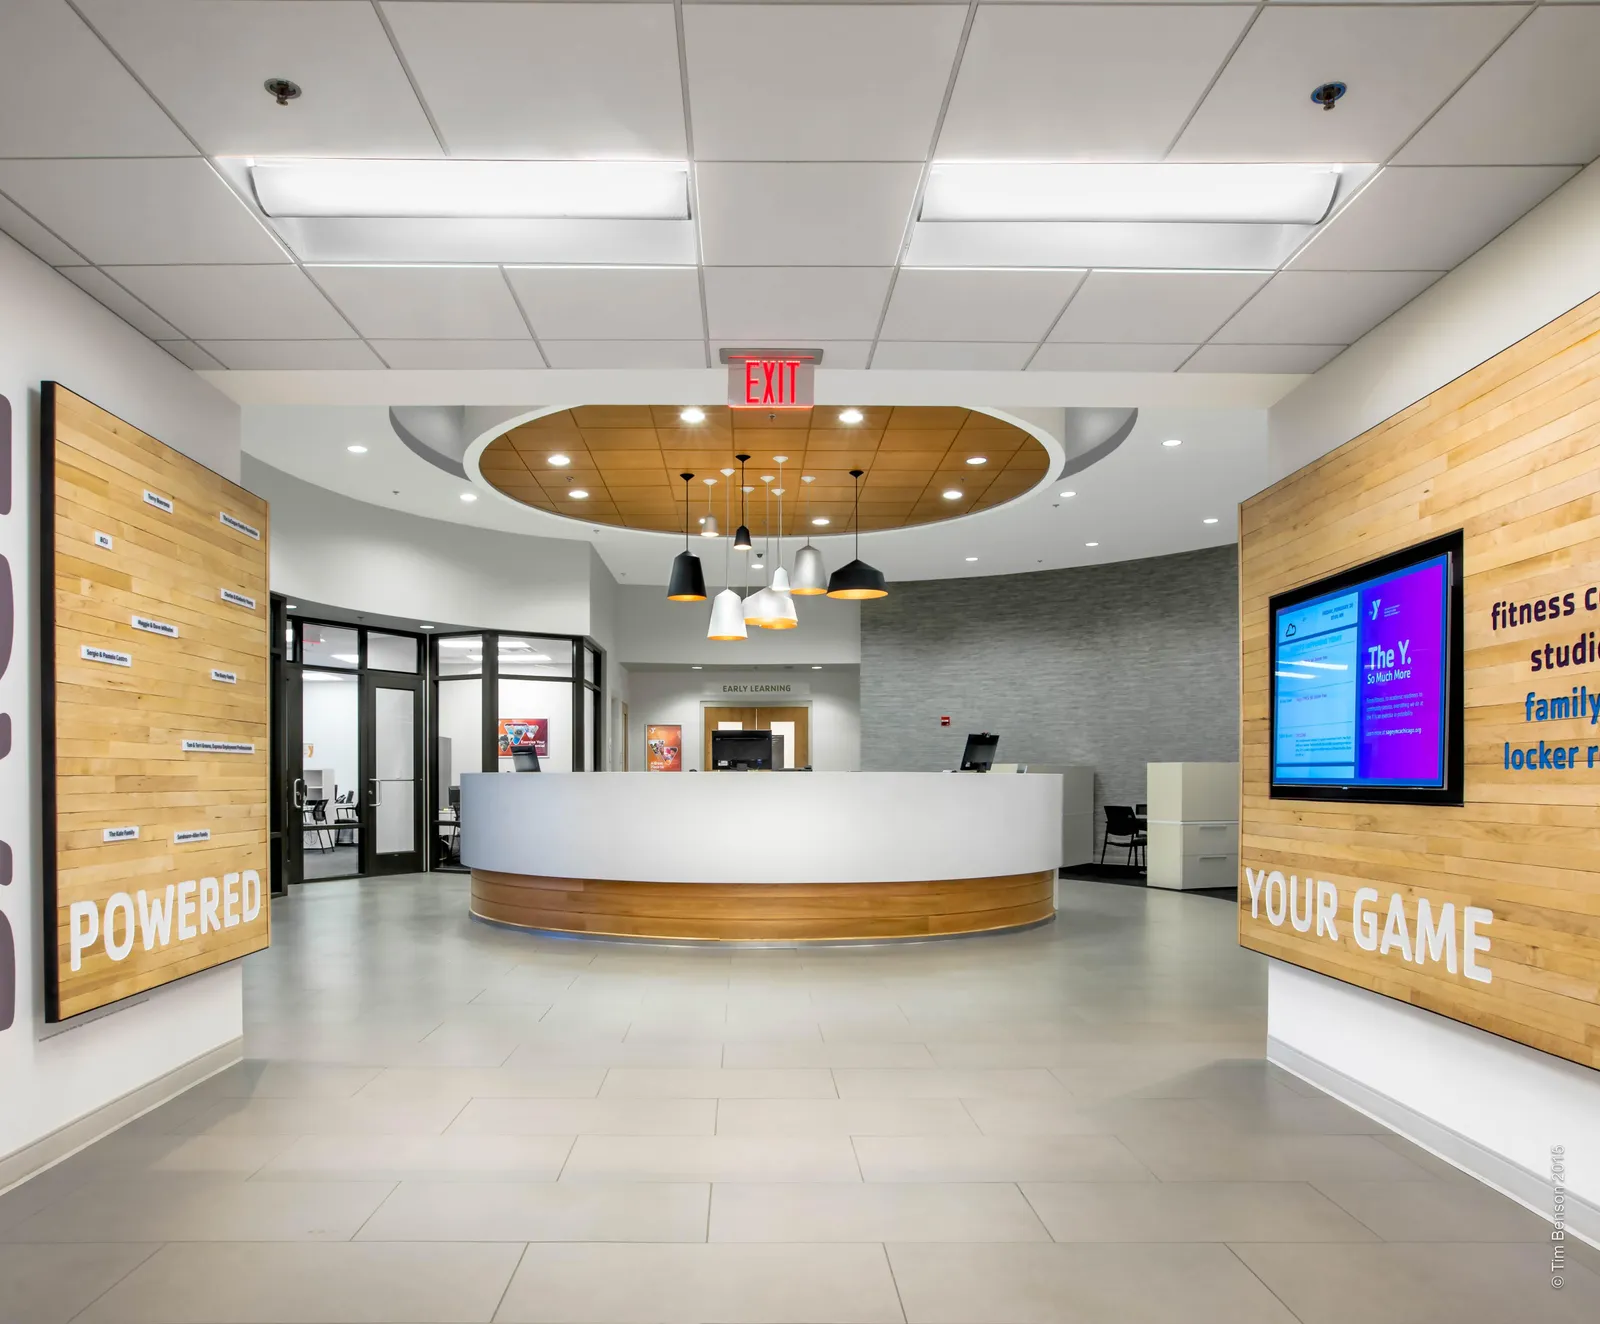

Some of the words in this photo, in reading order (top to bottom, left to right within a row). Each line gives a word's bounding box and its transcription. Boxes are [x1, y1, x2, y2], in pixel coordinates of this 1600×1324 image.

[745, 360, 801, 404] EXIT
[1491, 592, 1575, 631] fitness
[1585, 586, 1600, 611] c
[86, 648, 99, 658] Sergio
[1368, 645, 1394, 671] The
[1398, 639, 1411, 665] Y.
[1531, 632, 1600, 672] studi
[722, 685, 748, 693] EARLY
[750, 684, 791, 693] LEARNING
[1367, 674, 1375, 684] So
[1376, 671, 1392, 683] Much
[1394, 669, 1411, 680] More
[1525, 686, 1600, 725] family
[1504, 740, 1579, 770] locker
[1588, 745, 1600, 768] r
[70, 869, 261, 972] POWERED
[1245, 867, 1339, 942] YOUR
[1353, 887, 1494, 984] GAME
